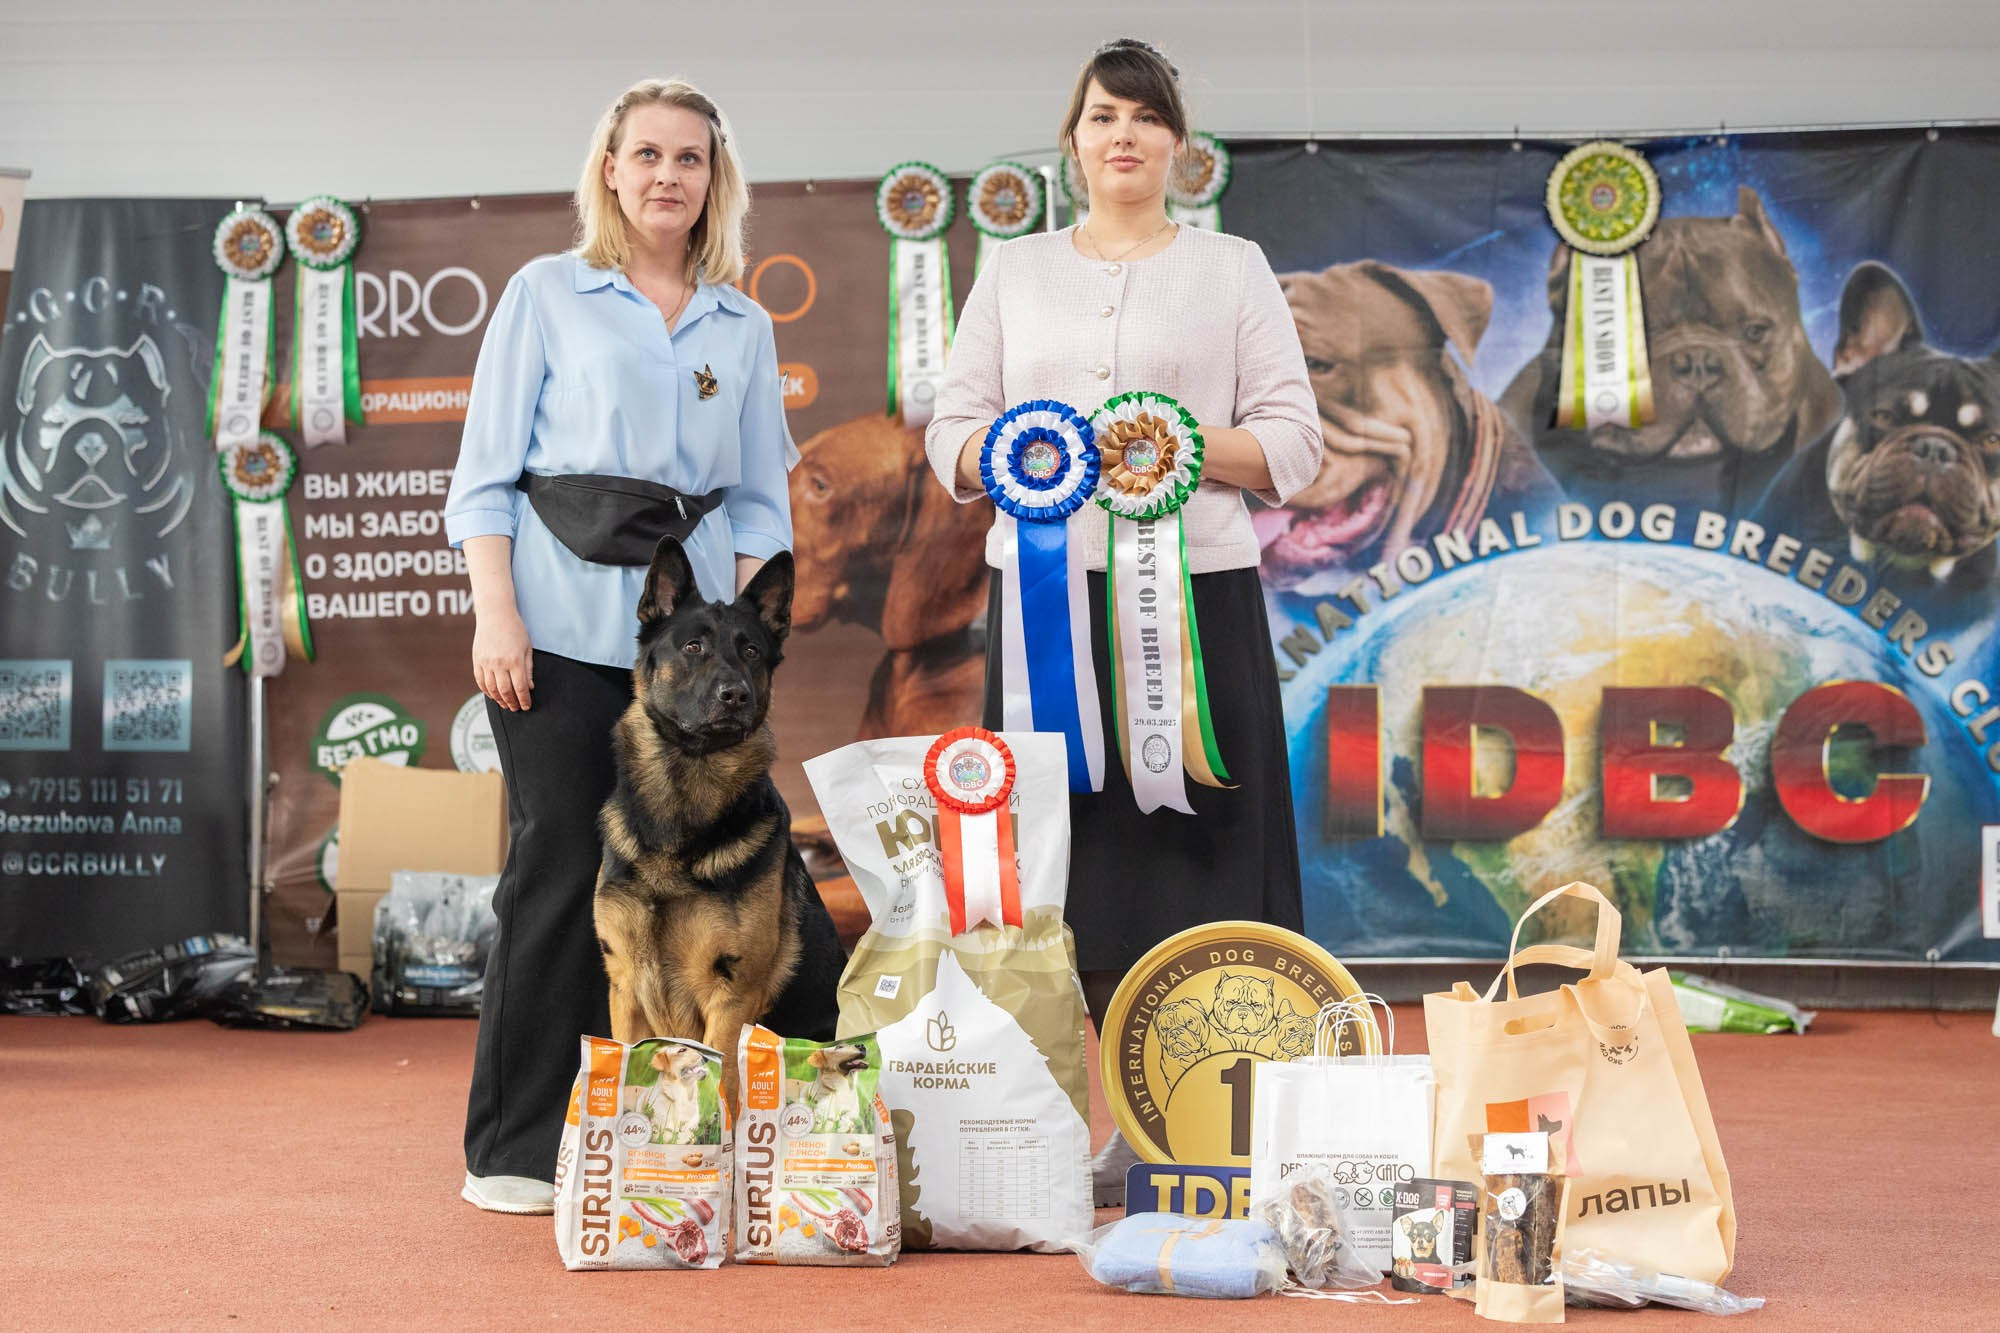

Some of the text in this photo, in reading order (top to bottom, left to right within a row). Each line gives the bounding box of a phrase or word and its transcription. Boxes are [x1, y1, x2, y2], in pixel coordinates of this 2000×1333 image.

[303, 468, 455, 499] ВЫ ЖИВЕ
[305, 509, 448, 539] МЫ ЗАБО
[8, 552, 174, 605] BULLY
[305, 553, 326, 579] О
[307, 592, 431, 619] ВАШЕГО
[1277, 511, 1541, 681] NATIONAL
[1557, 502, 1677, 542] DOG
[1692, 510, 1954, 677] BREEDERS
[1137, 519, 1164, 711] BEST OF BREED
[317, 724, 419, 768] БЕЗ ГМО
[1326, 681, 1931, 843] IDBC
[16, 778, 183, 803] +7915 111 51 71
[121, 809, 183, 834] Anna
[1130, 965, 1193, 1123] INTERNATIONAL
[1209, 949, 1255, 965] DOG
[888, 1059, 996, 1075] ГВАРДЕЙСКИЕ
[591, 1087, 613, 1097] ADULT
[752, 1081, 775, 1091] ADULT
[913, 1077, 970, 1090] КОРМА
[787, 1115, 809, 1127] 44%
[1221, 1057, 1251, 1156] 1
[624, 1125, 646, 1136] 44%
[747, 1122, 776, 1248] SIRIUS
[1376, 1163, 1415, 1182] GATO
[580, 1129, 614, 1257] SIRIUS
[1578, 1178, 1692, 1219] лапы
